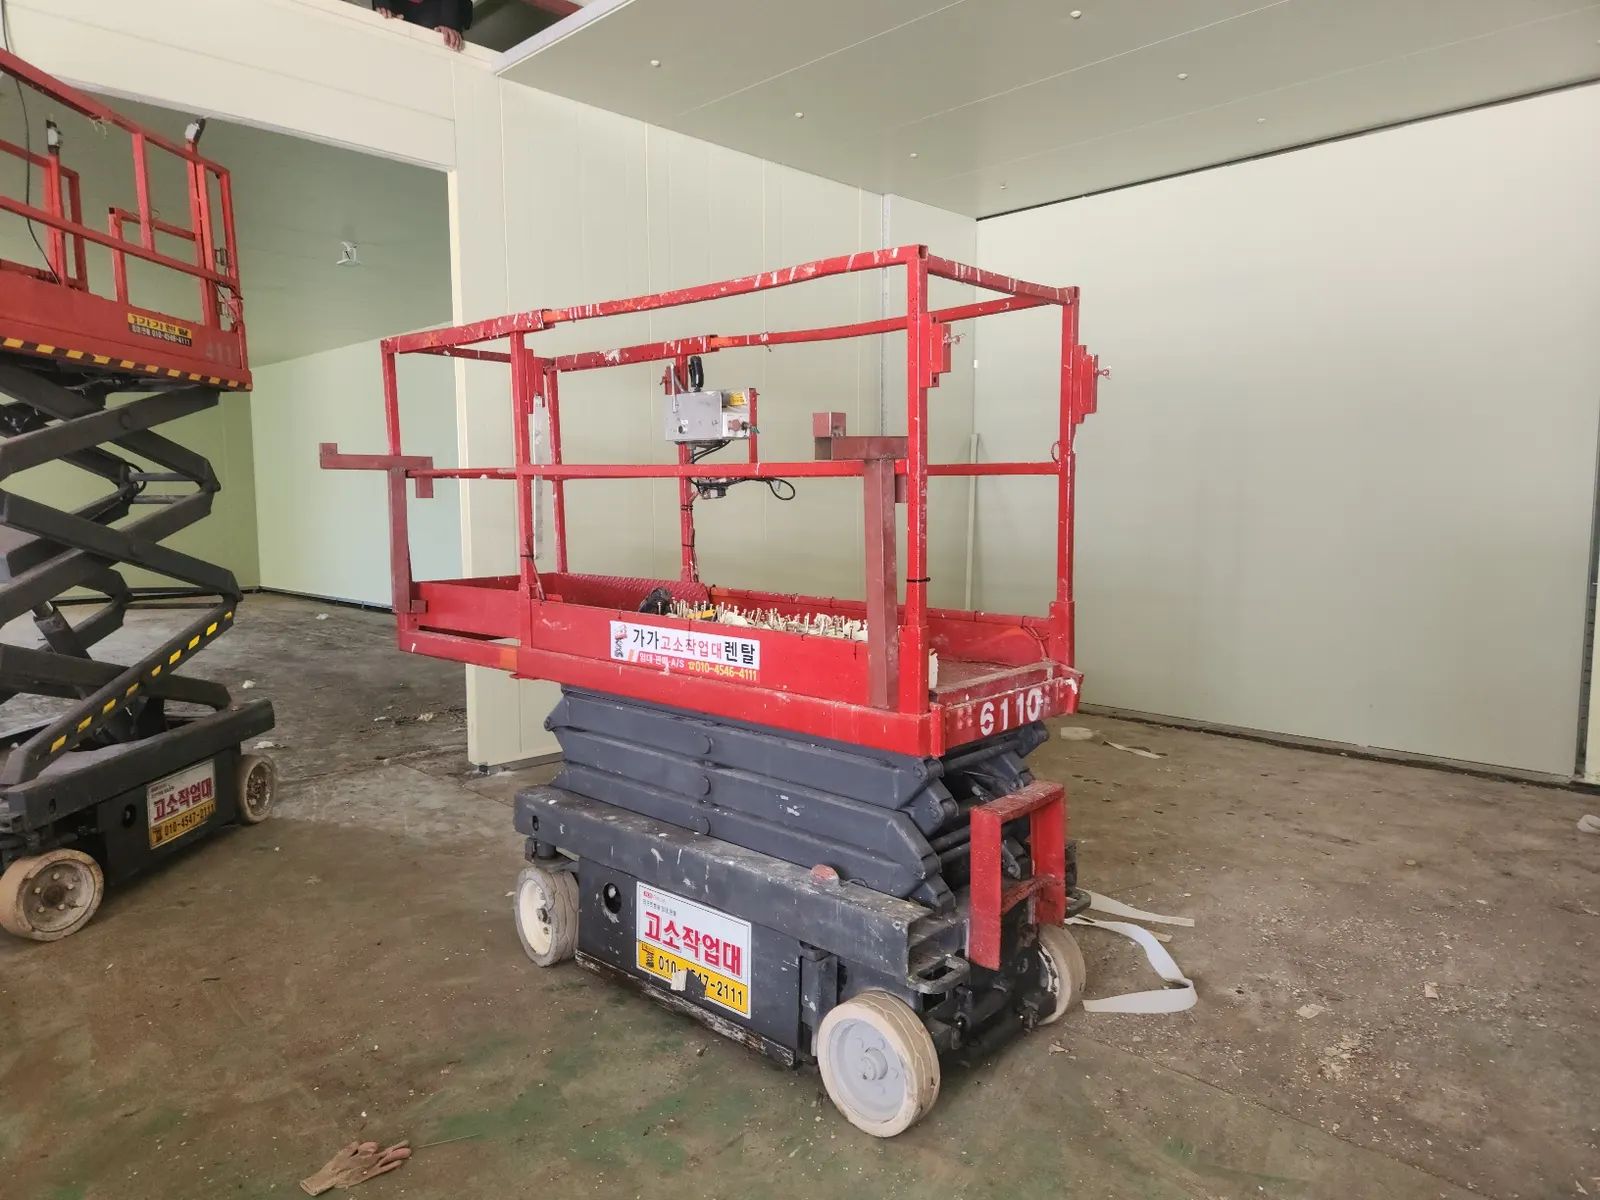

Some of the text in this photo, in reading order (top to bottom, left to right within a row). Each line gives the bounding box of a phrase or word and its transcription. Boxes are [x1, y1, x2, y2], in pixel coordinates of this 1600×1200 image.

[695, 661, 757, 681] 010-4546-4111
[980, 687, 1043, 736] 6110
[153, 777, 213, 822] 고소작업대
[644, 911, 742, 977] 고소작업대
[658, 955, 743, 1006] 010-47-2111
